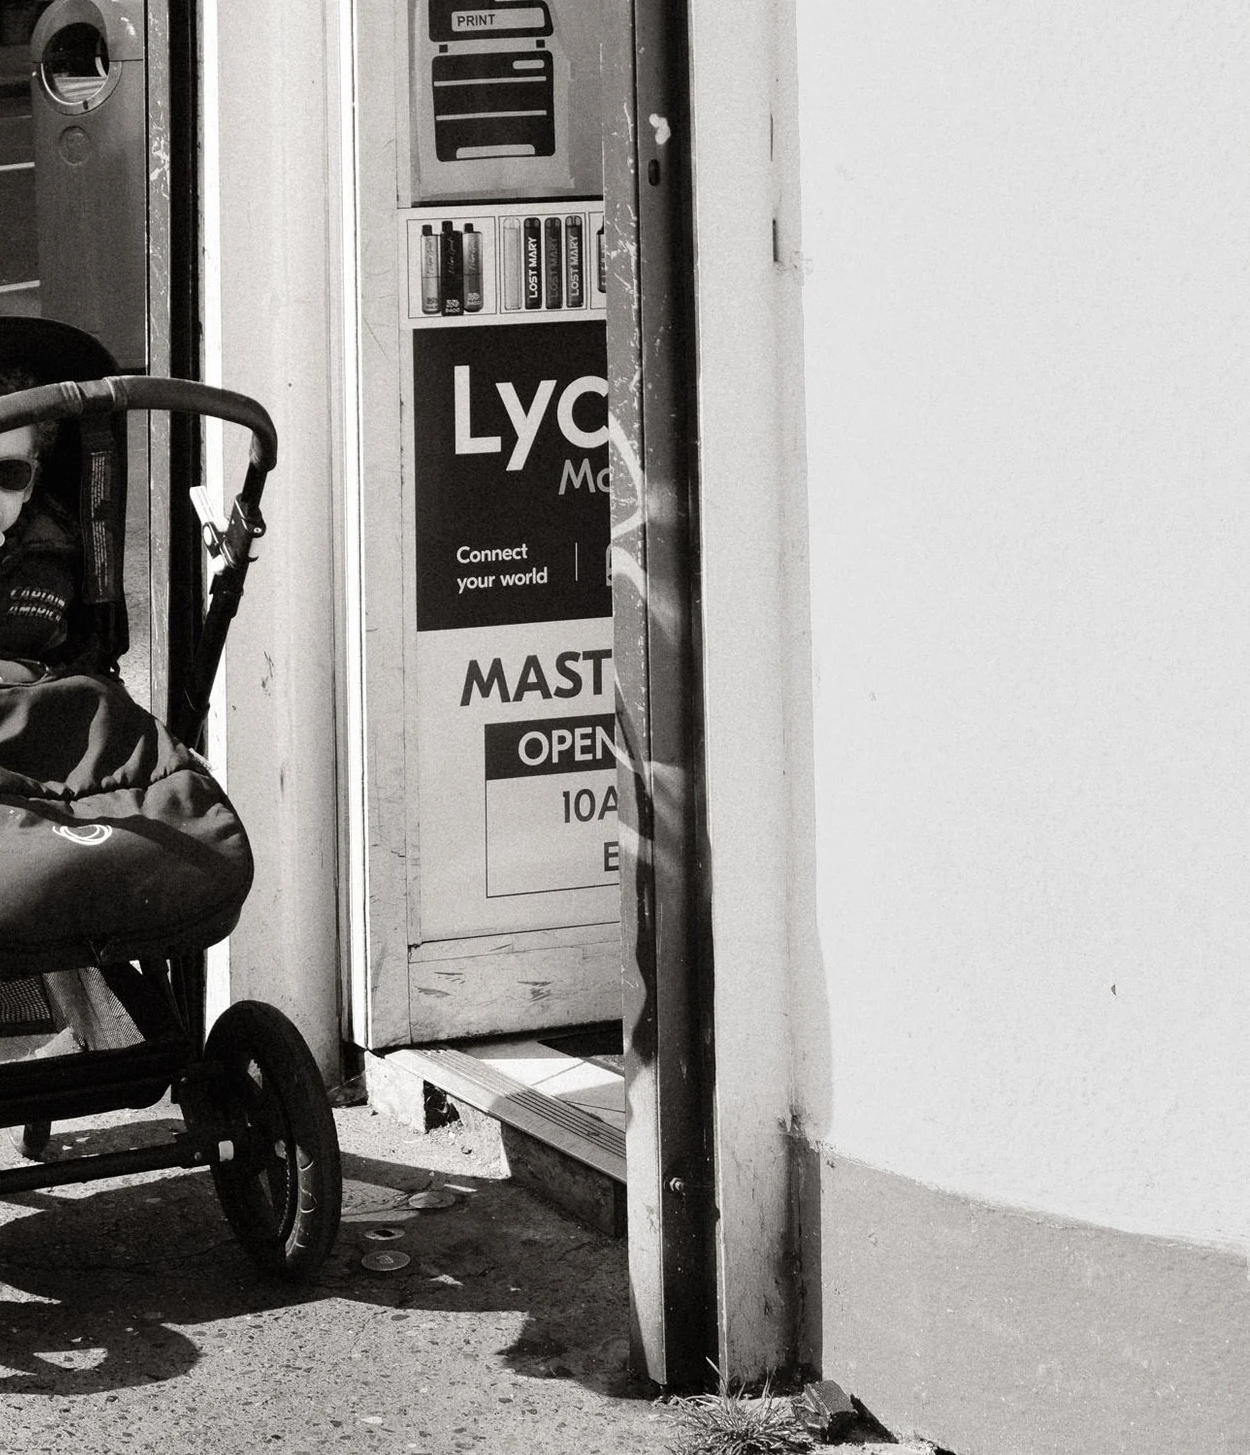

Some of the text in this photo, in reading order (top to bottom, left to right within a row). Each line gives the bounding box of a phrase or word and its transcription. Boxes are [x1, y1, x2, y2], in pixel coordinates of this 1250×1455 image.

[457, 14, 495, 27] PRINT
[528, 237, 537, 298] LOST MARY
[569, 235, 579, 296] LOST MARY
[456, 543, 528, 564] Connect
[457, 567, 548, 593] your world
[460, 649, 612, 707] MAST
